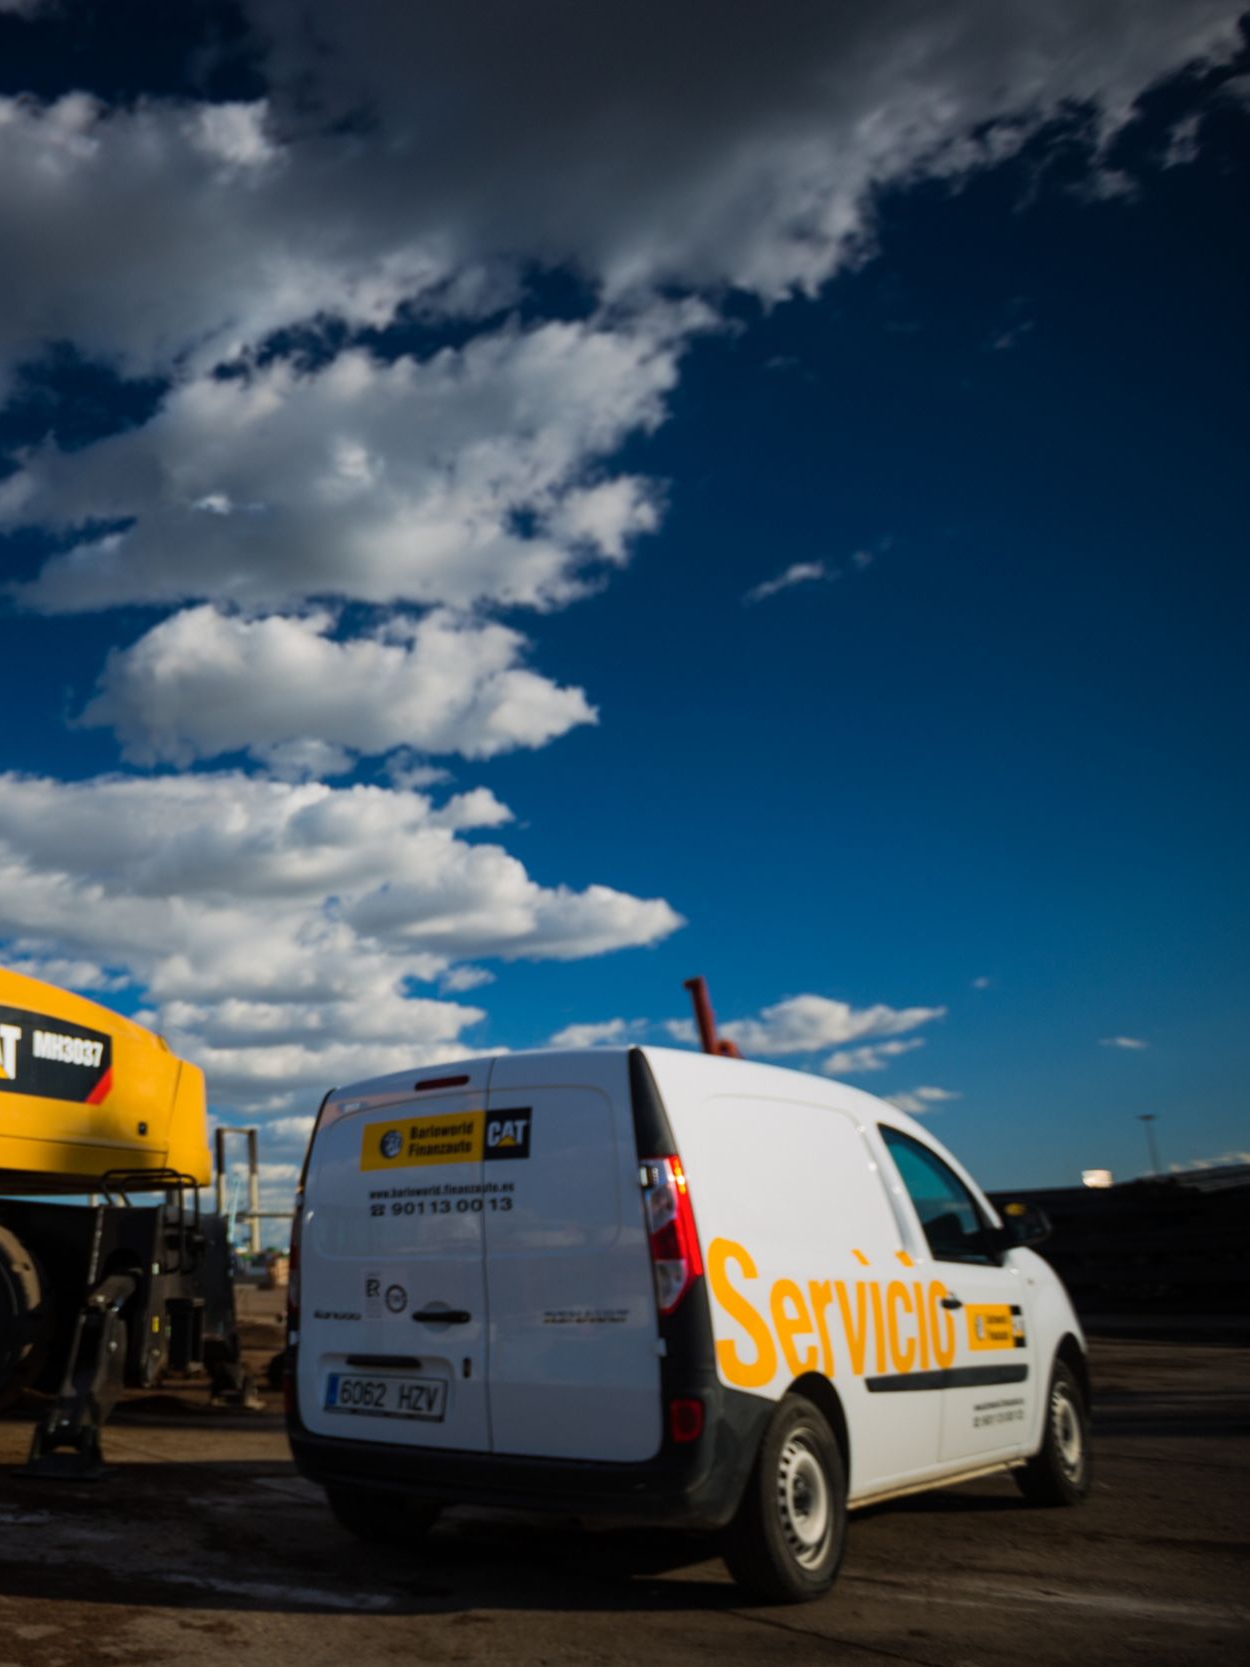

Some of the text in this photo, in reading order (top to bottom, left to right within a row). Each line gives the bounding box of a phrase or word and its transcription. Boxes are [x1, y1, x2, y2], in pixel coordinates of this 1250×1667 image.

[32, 1029, 103, 1068] MH3037
[487, 1119, 527, 1147] CAT
[408, 1138, 472, 1158] Finanzauto
[392, 1197, 513, 1216] 901 13 00 13
[341, 1380, 439, 1412] 6062 HZV
